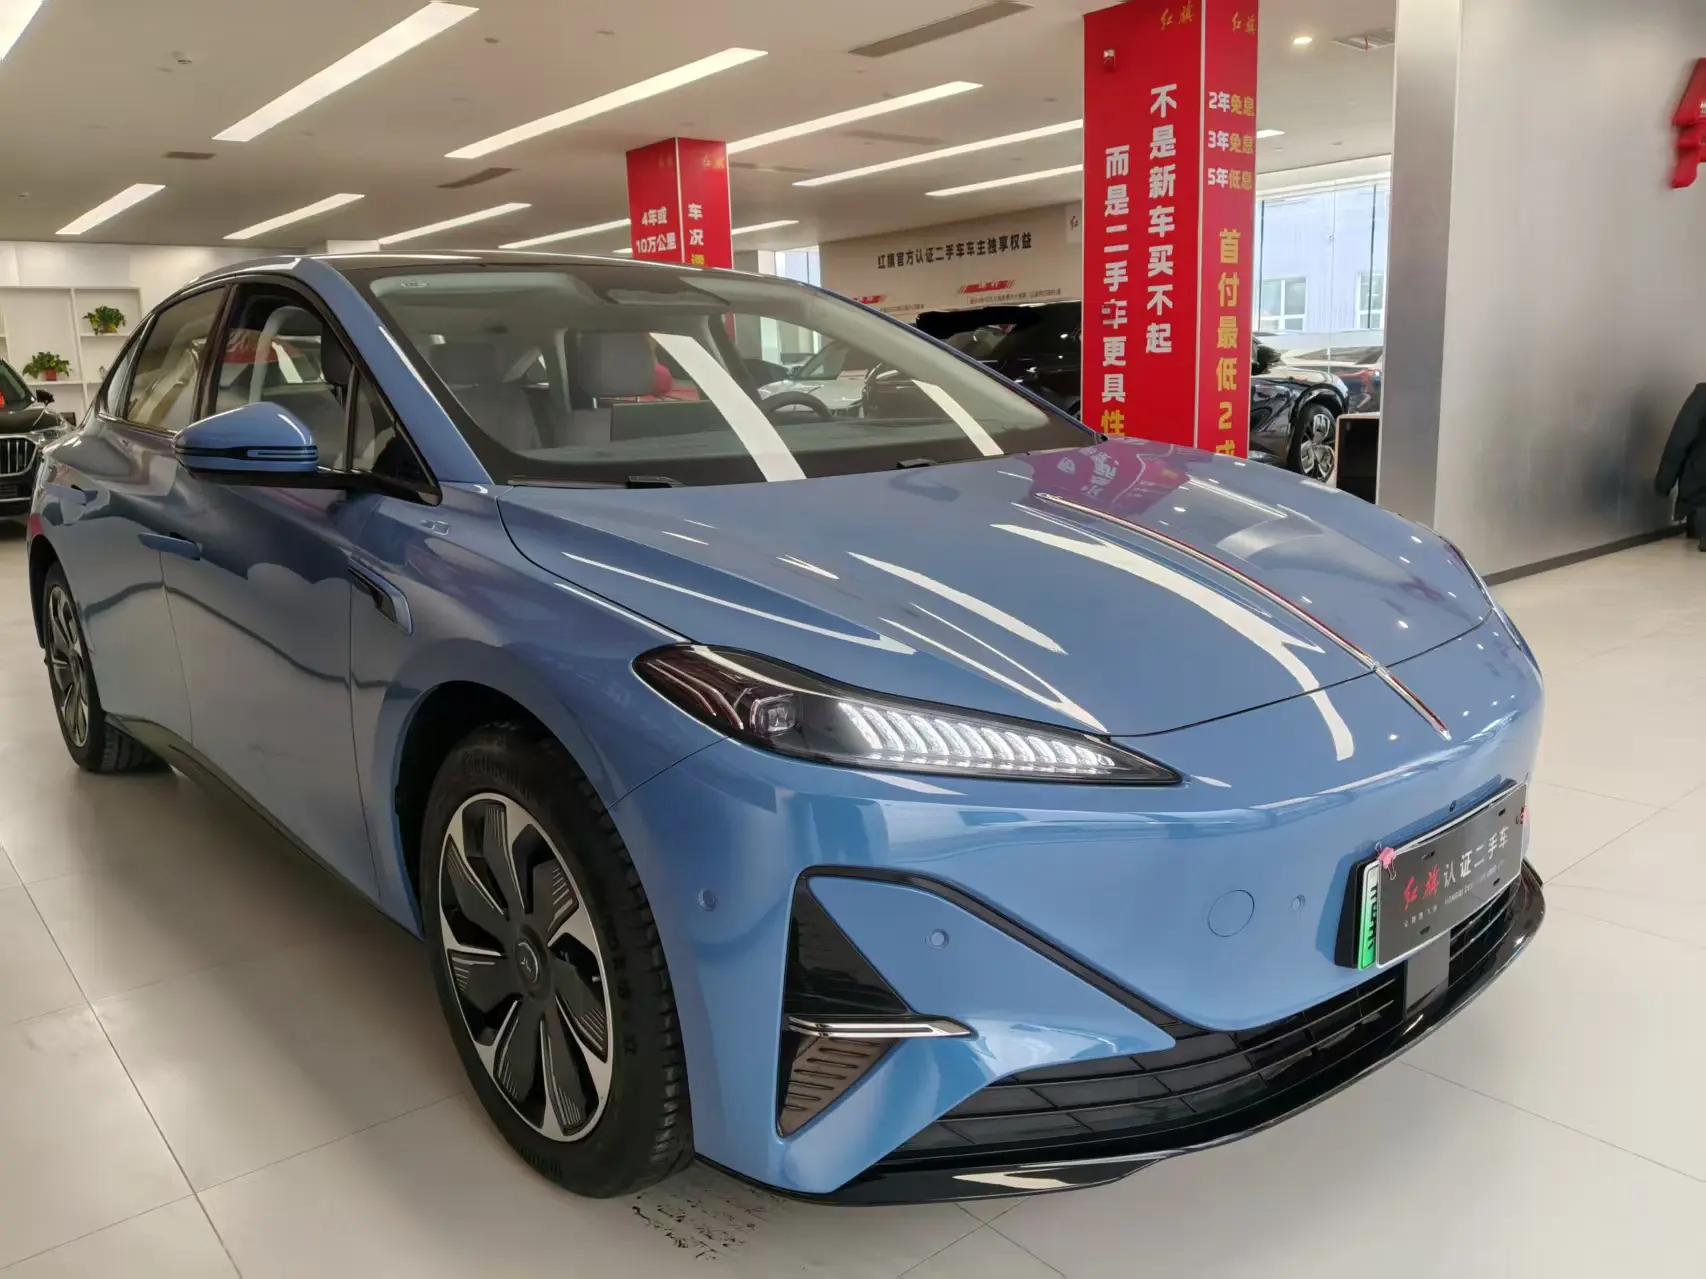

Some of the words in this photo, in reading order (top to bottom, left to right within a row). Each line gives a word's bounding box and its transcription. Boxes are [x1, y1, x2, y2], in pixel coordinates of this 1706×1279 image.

[1208, 91, 1256, 117] 2年免息
[1207, 130, 1254, 154] 3年免息
[1207, 167, 1253, 190] 5年低息
[641, 206, 668, 226] 4年或
[1145, 83, 1178, 354] 不是新车买不起
[636, 232, 677, 254] 10万公里
[877, 231, 1033, 269] 红旗官方认证二手车车主独享权益
[1100, 144, 1131, 436] 而是二手车更具性
[1443, 826, 1509, 888] 认证二手车
